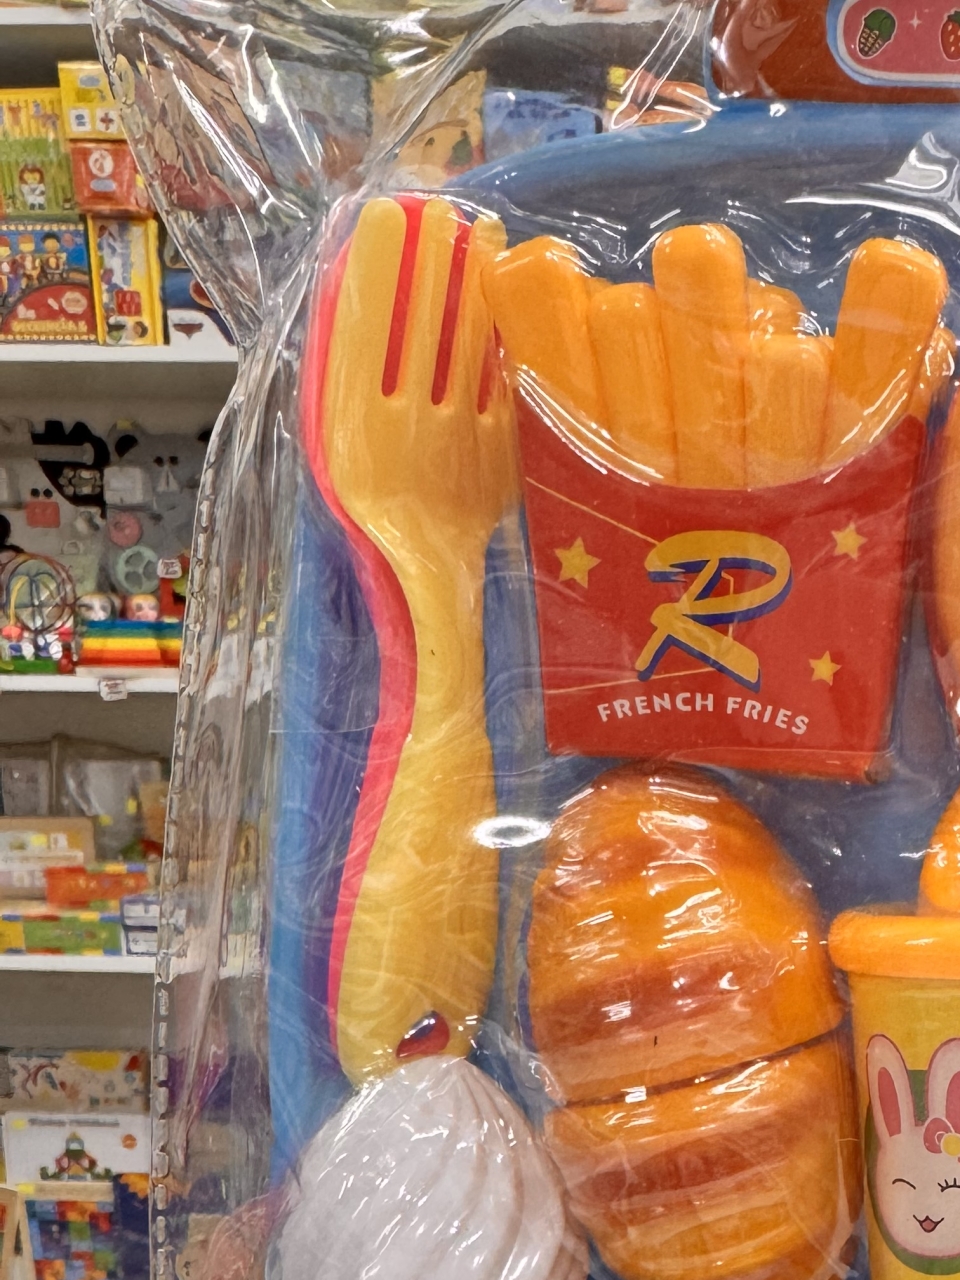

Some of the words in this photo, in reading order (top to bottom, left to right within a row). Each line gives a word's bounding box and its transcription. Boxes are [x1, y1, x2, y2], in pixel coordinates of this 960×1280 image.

[635, 530, 793, 692] R
[597, 692, 714, 723] FRENCH
[726, 697, 810, 735] FRIES
